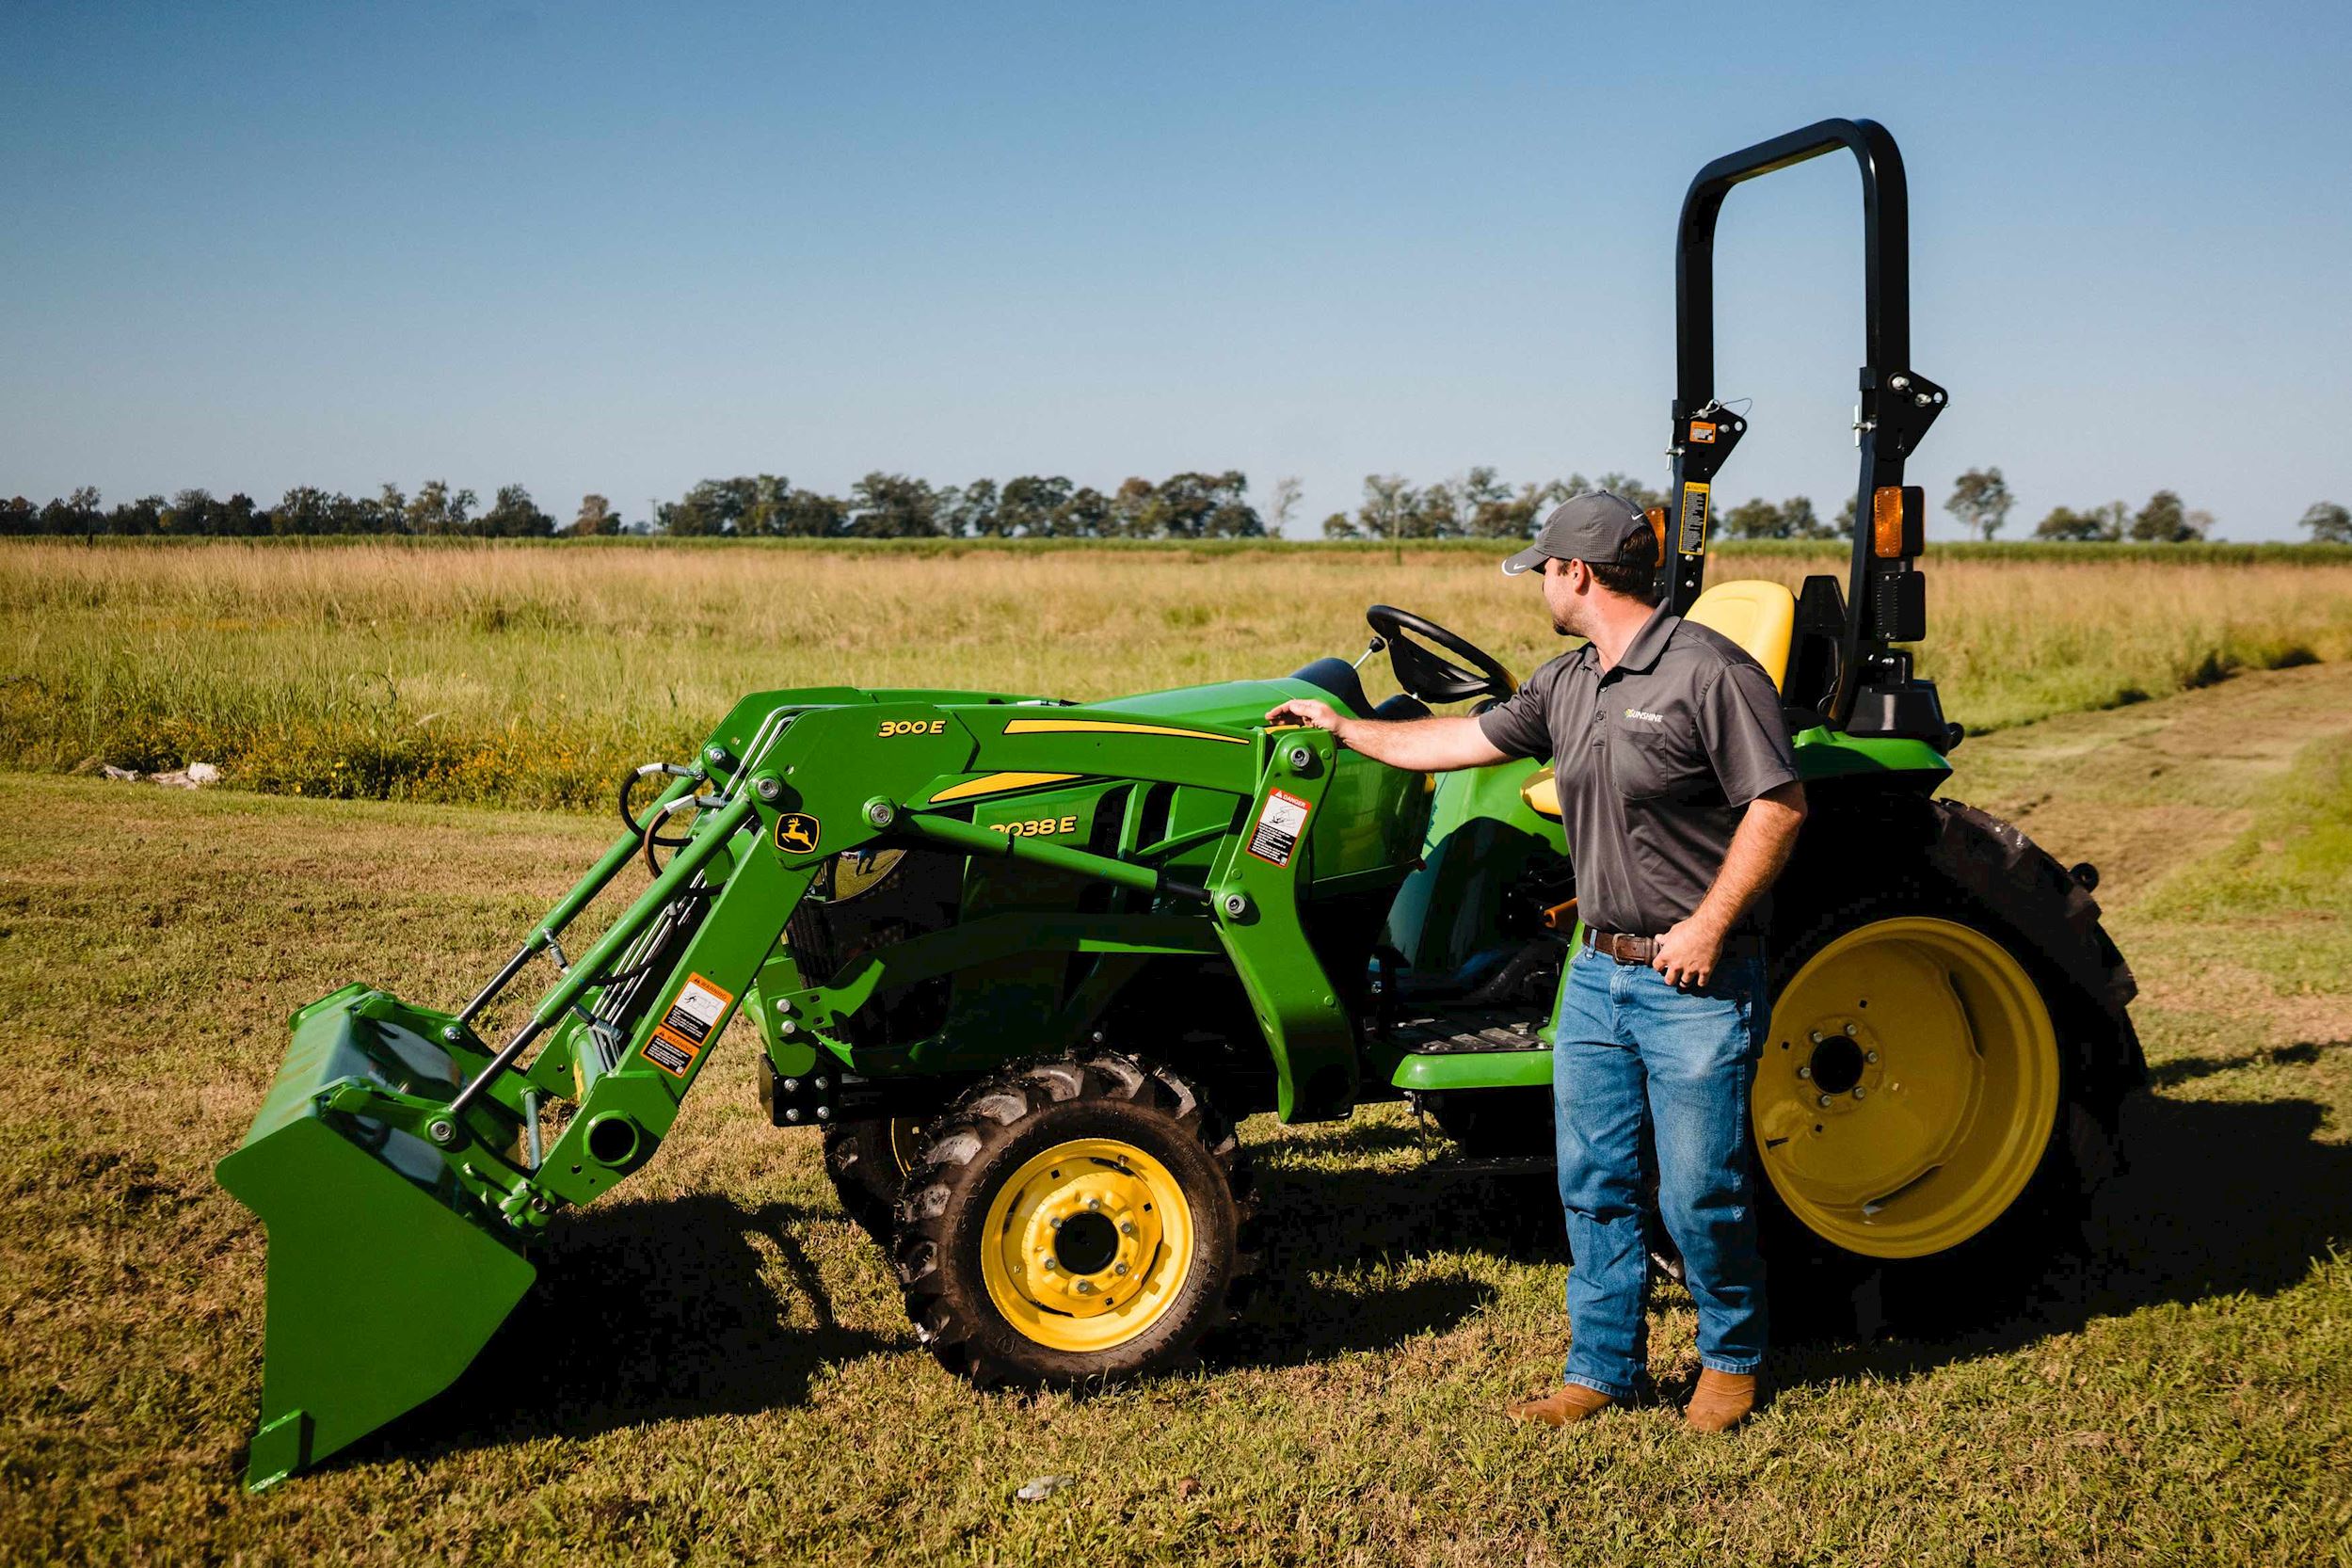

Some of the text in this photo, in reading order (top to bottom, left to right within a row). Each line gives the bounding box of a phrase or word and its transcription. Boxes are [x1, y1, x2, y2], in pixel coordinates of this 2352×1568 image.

[1282, 794, 1307, 808] DANGER
[701, 981, 728, 1000] WARNING
[666, 1033, 694, 1053] WARNING
